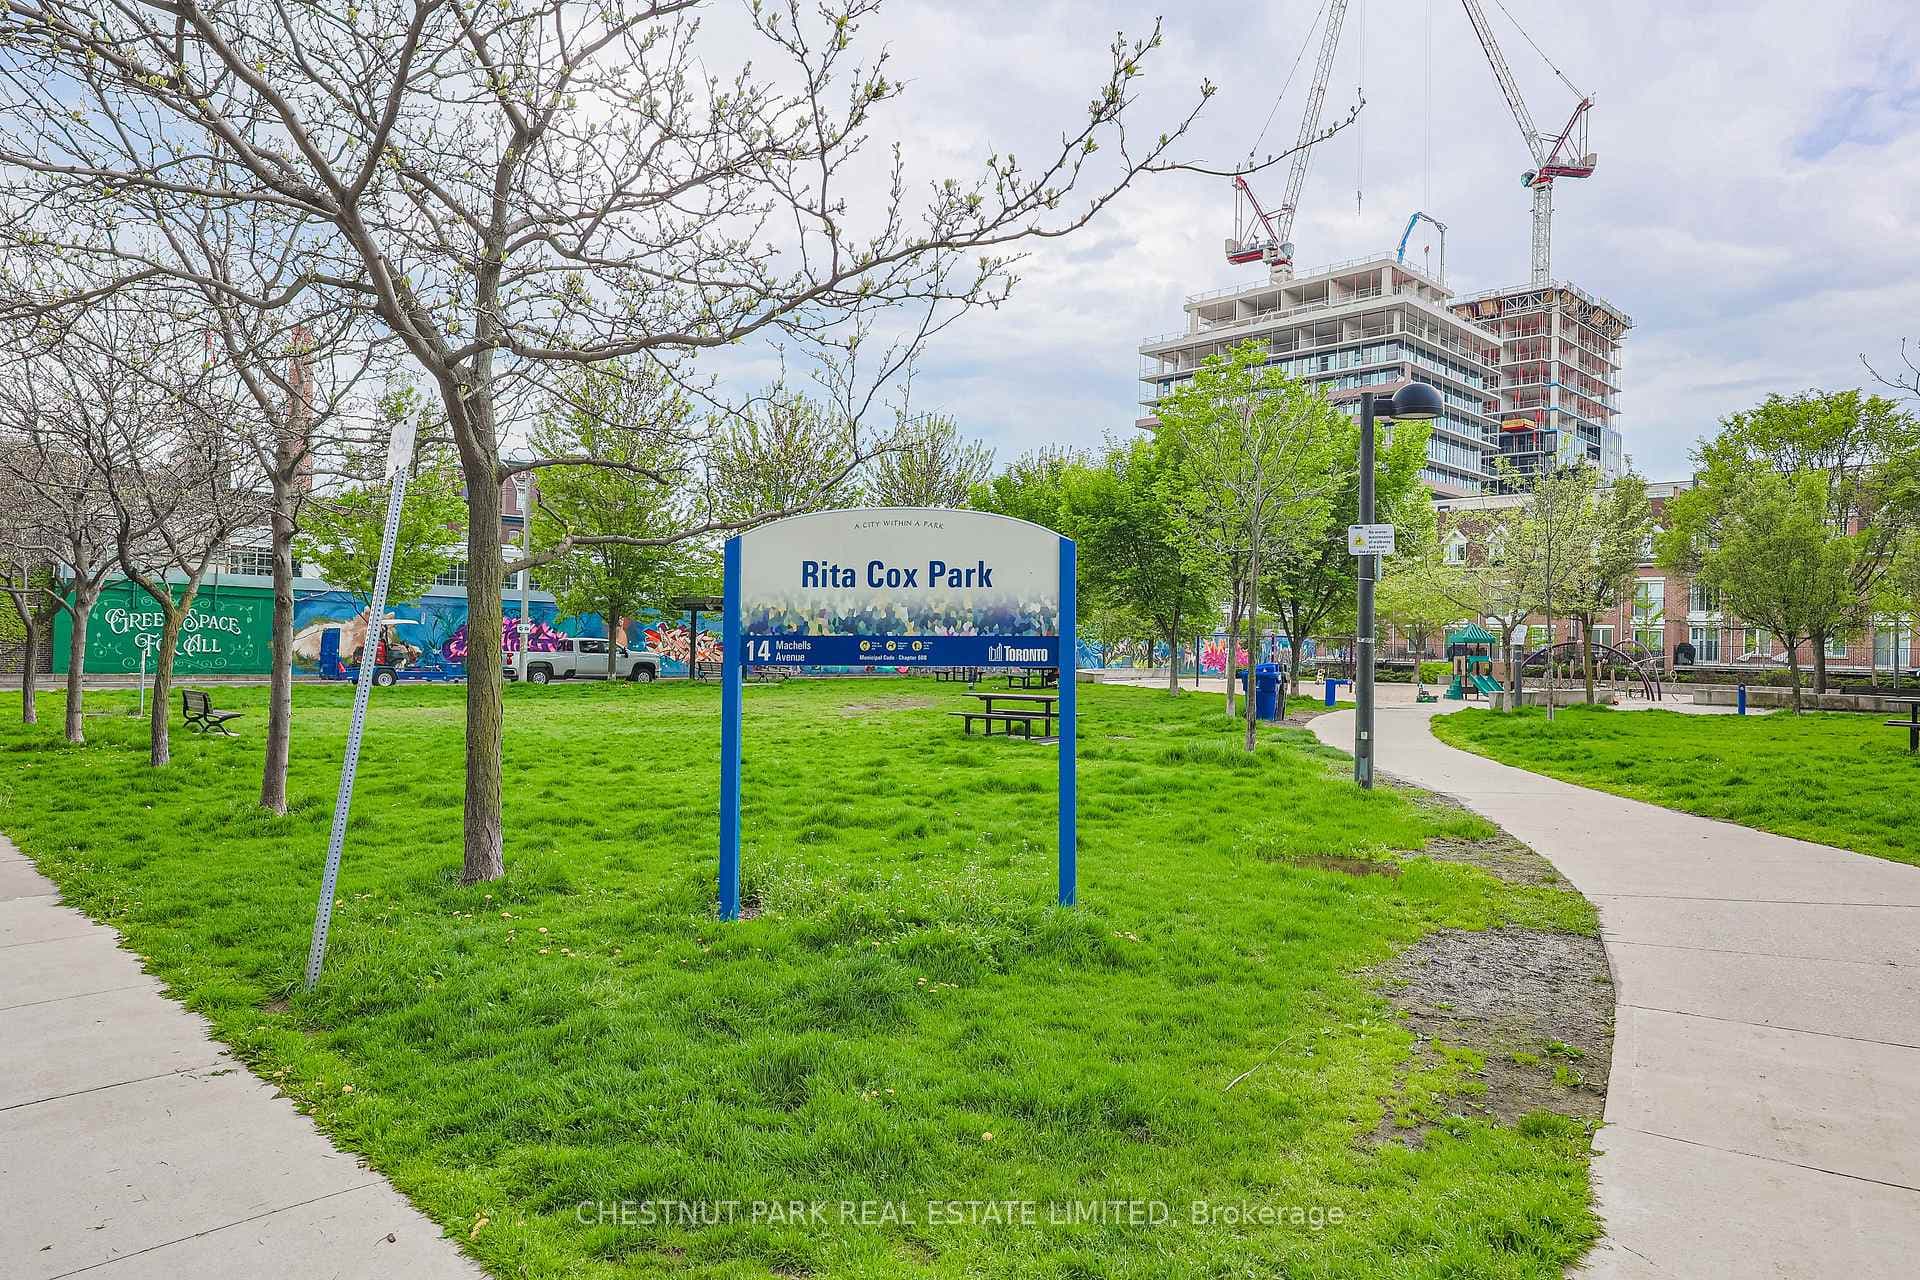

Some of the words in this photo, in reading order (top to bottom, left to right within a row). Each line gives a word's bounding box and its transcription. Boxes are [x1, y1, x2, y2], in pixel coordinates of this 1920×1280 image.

[923, 521, 945, 529] PARK
[801, 560, 856, 588] Rita
[867, 560, 918, 588] Cox
[929, 560, 993, 588] Park
[105, 608, 164, 635] GREE
[182, 608, 241, 635] SPACE
[183, 633, 222, 657] ALL
[746, 640, 771, 661] 14
[775, 640, 812, 650] Machells
[1004, 645, 1048, 662] TORONTO
[775, 652, 805, 661] Avenue
